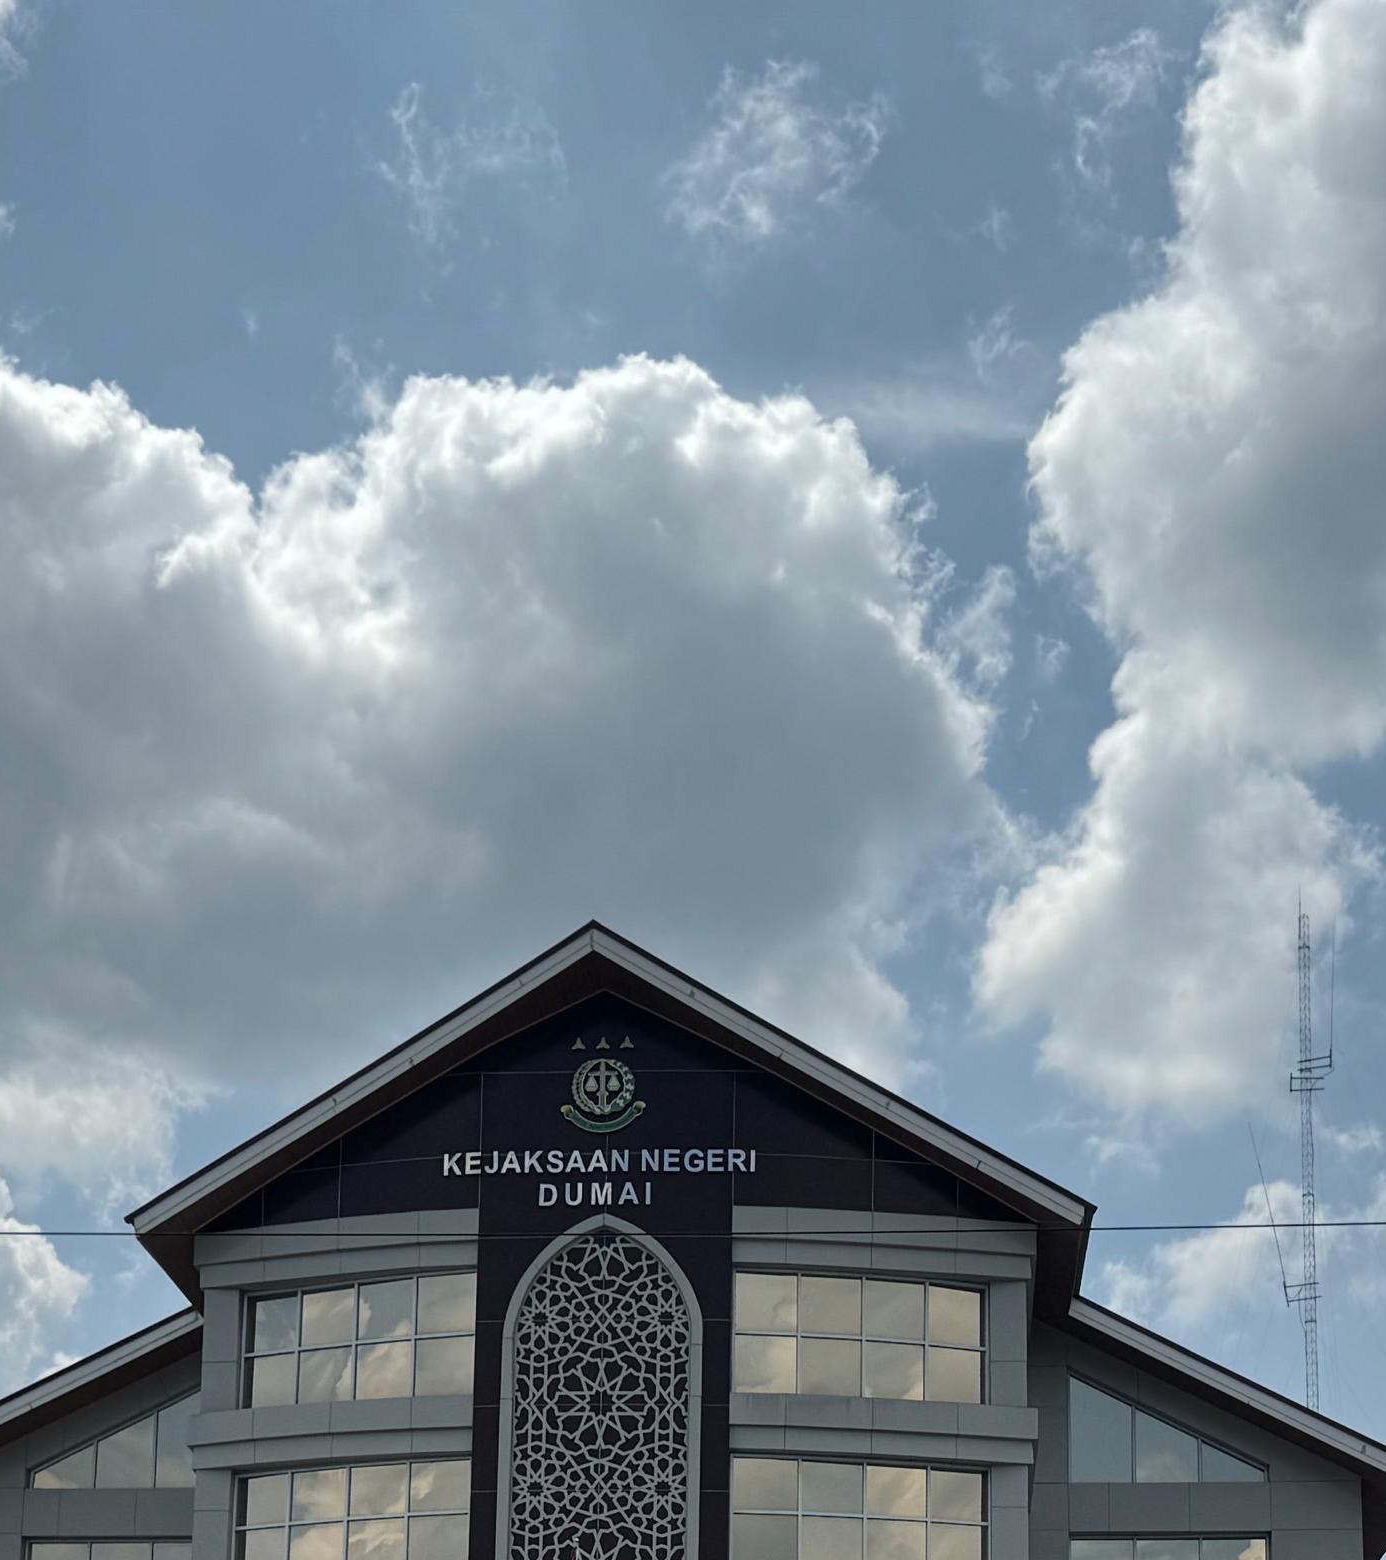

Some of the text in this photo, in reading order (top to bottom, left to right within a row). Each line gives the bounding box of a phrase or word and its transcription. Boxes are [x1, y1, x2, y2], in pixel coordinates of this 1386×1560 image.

[442, 1148, 757, 1177] KEJAKSAAN NEGERI
[538, 1181, 652, 1207] DUMAI
